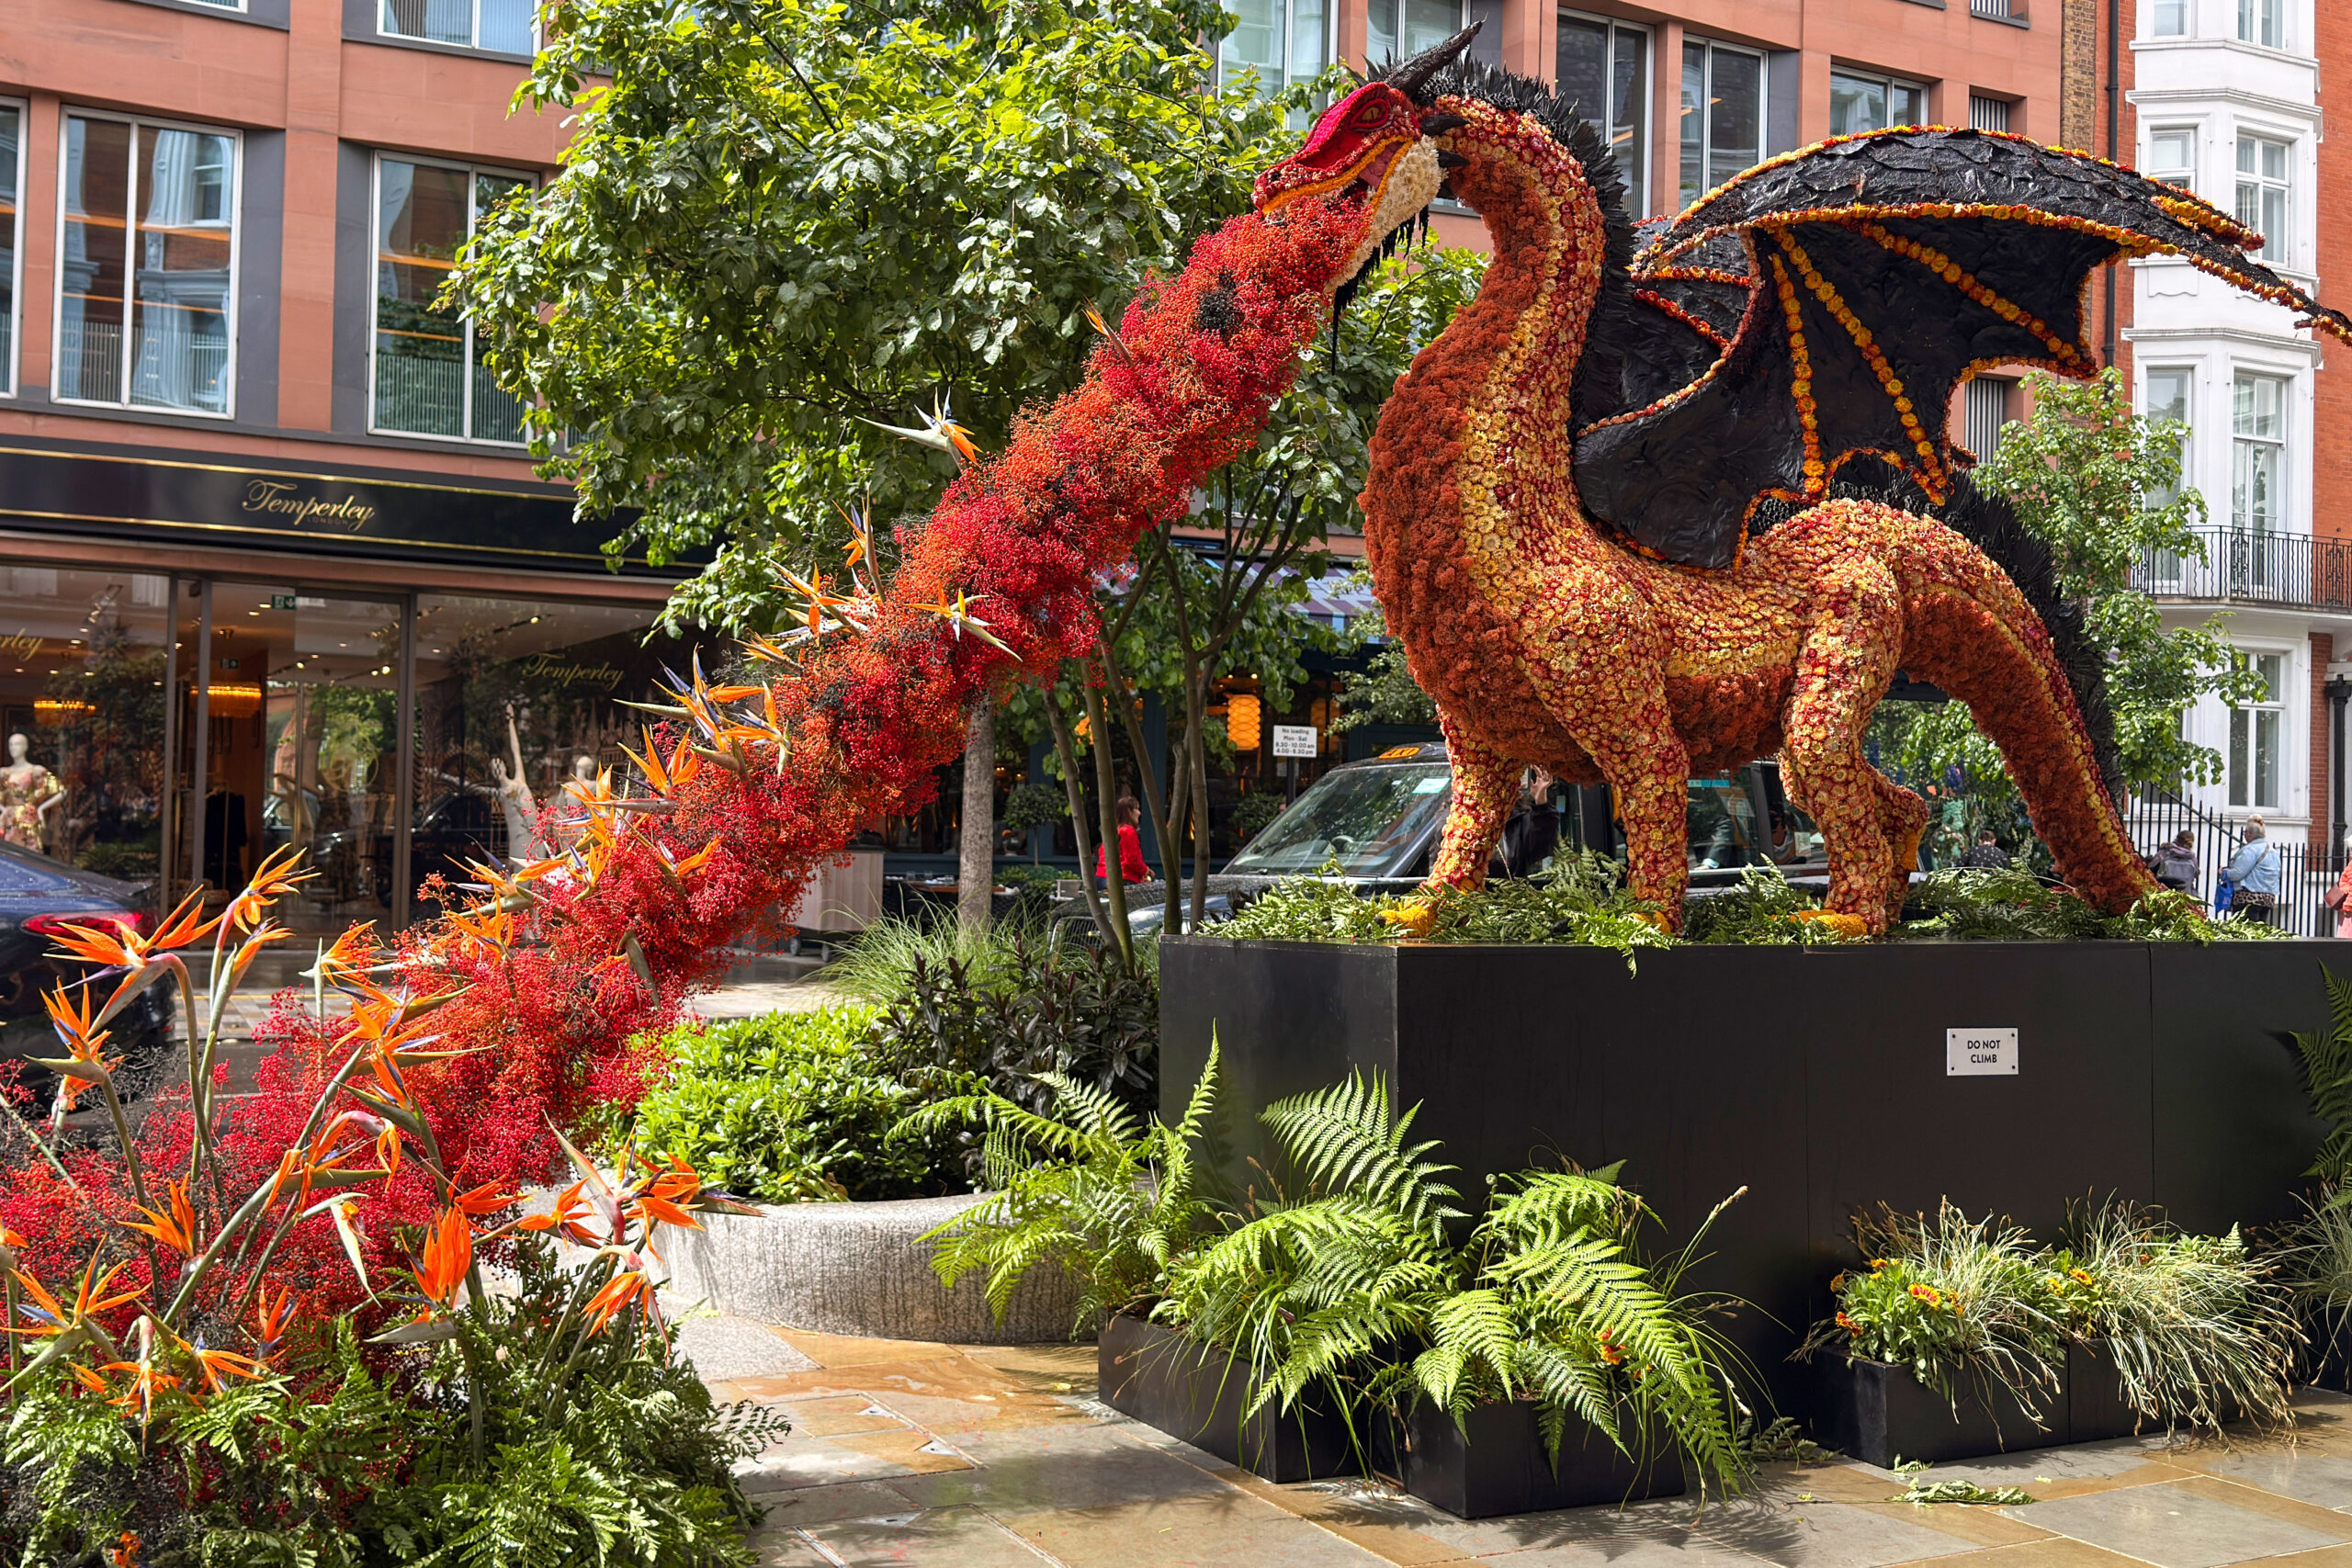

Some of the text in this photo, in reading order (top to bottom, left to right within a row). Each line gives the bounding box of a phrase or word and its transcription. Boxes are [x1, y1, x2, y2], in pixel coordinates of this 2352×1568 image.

[243, 479, 375, 532] Temperley
[306, 517, 348, 526] LONDON
[0, 628, 43, 661] rley
[522, 652, 624, 691] Temperley
[1967, 1040, 2001, 1050] DO NOT
[1971, 1054, 1997, 1064] CLIMB
